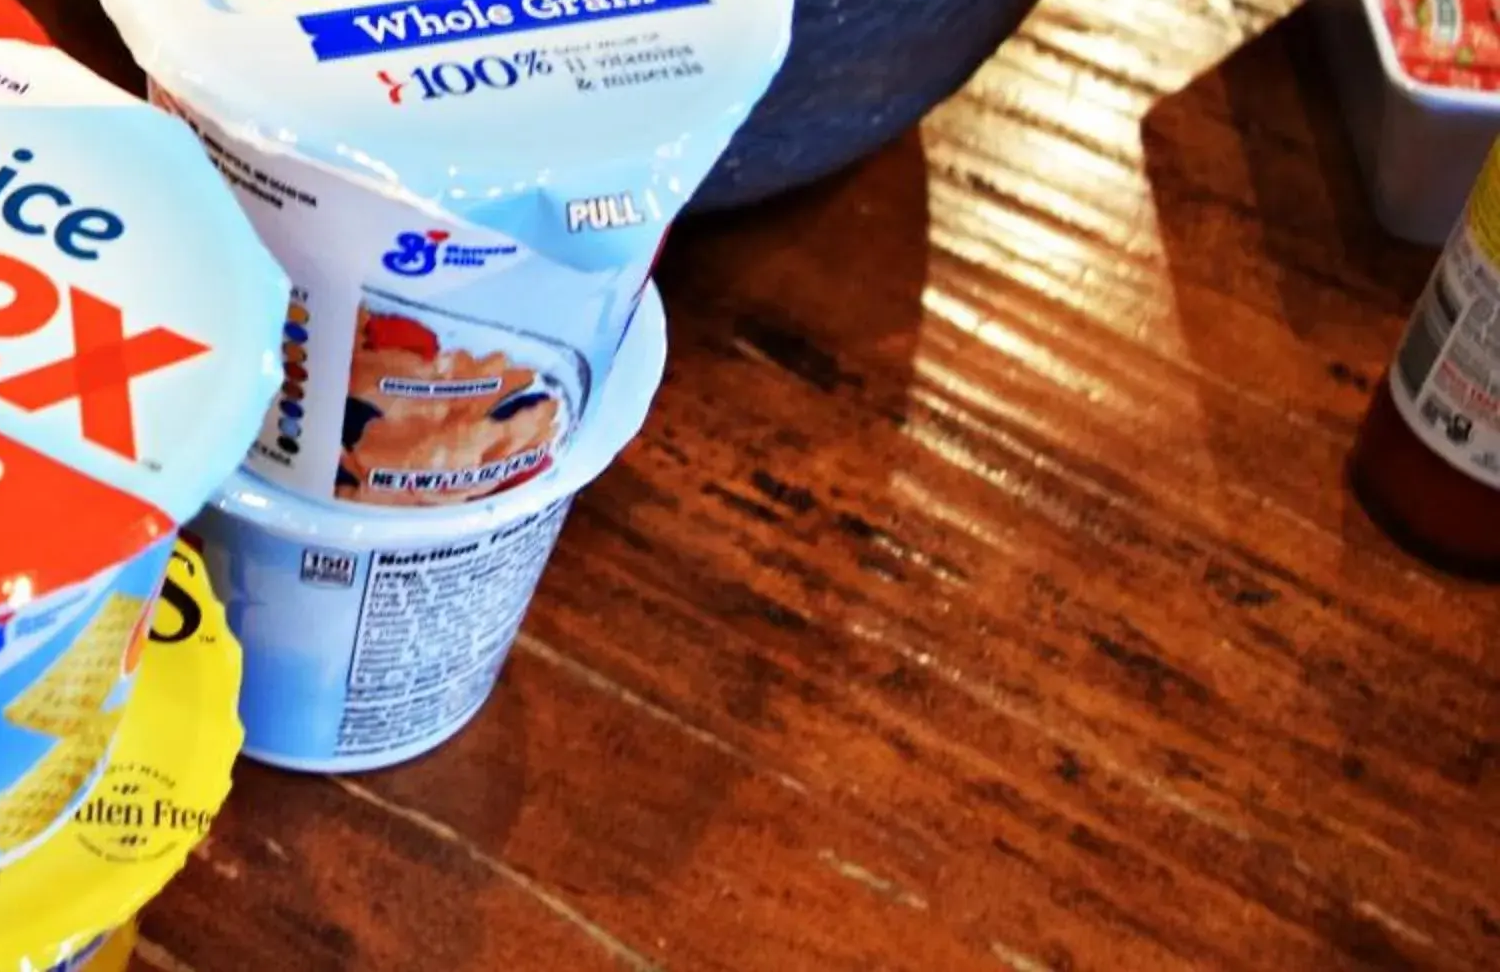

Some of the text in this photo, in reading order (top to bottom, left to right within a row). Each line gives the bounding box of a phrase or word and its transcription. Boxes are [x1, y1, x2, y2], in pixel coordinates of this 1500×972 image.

[594, 44, 695, 69] vitamins
[602, 62, 704, 90] minerals
[566, 191, 644, 233] PULL
[377, 541, 480, 567] Nutrition
